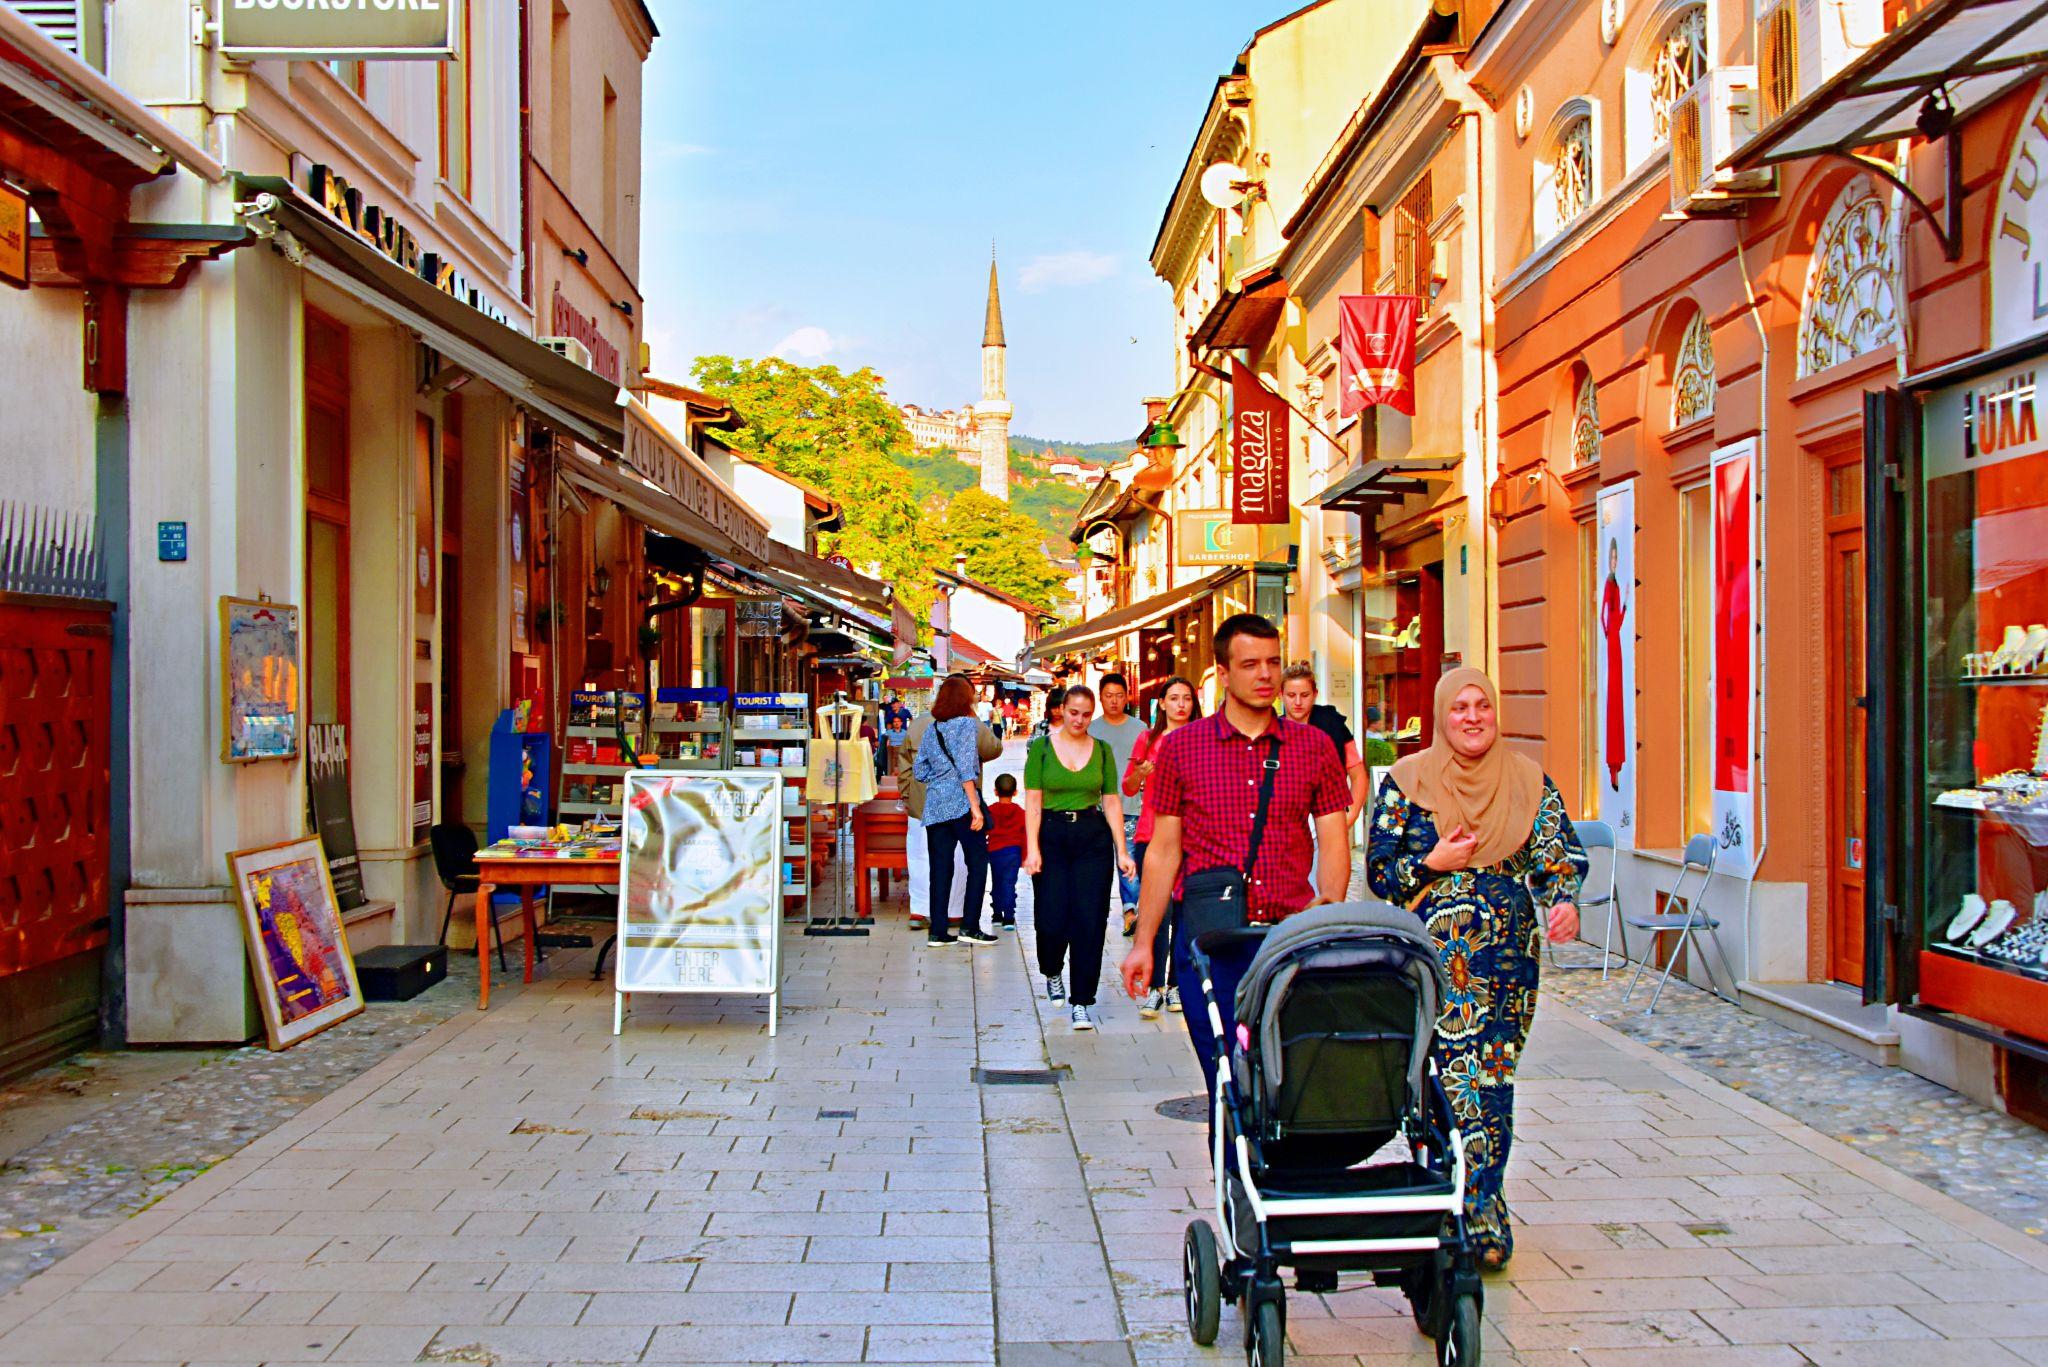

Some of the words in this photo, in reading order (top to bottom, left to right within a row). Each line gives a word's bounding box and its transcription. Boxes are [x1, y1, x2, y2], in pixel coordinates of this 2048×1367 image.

[629, 423, 666, 484] KLUB
[1240, 410, 1273, 513] magaza
[1274, 427, 1283, 499] SARAJEVO
[1187, 553, 1251, 561] BARBERSHOP
[574, 693, 609, 703] TOURIST
[736, 696, 772, 706] TOURIST
[309, 724, 348, 762] BLACK
[709, 804, 731, 817] THE
[674, 951, 720, 967] ENTER
[678, 967, 715, 983] HERE
